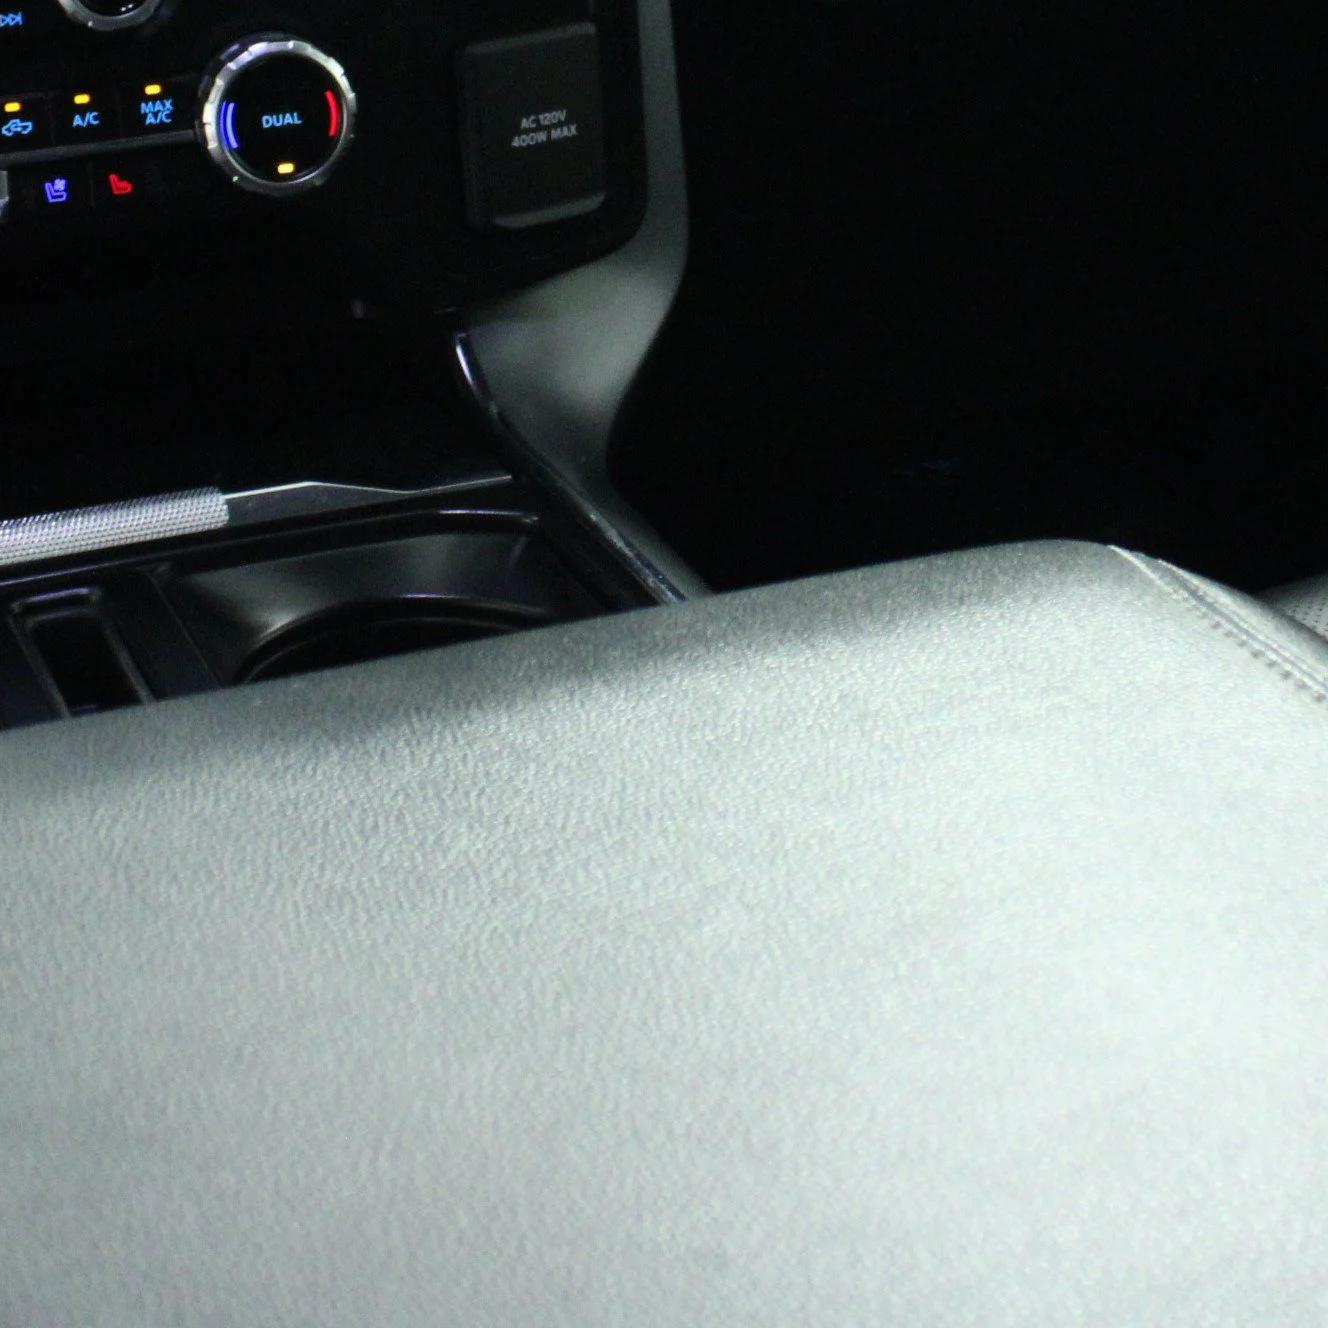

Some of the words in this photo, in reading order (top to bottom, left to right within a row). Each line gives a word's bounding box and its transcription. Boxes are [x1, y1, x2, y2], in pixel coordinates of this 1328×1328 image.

[140, 99, 173, 115] MAX
[72, 110, 100, 129] A/C
[145, 109, 173, 126] A/C
[261, 111, 303, 129] DUAL
[519, 115, 537, 131] AC
[511, 130, 548, 148] 400W
[550, 123, 578, 141] MAX
